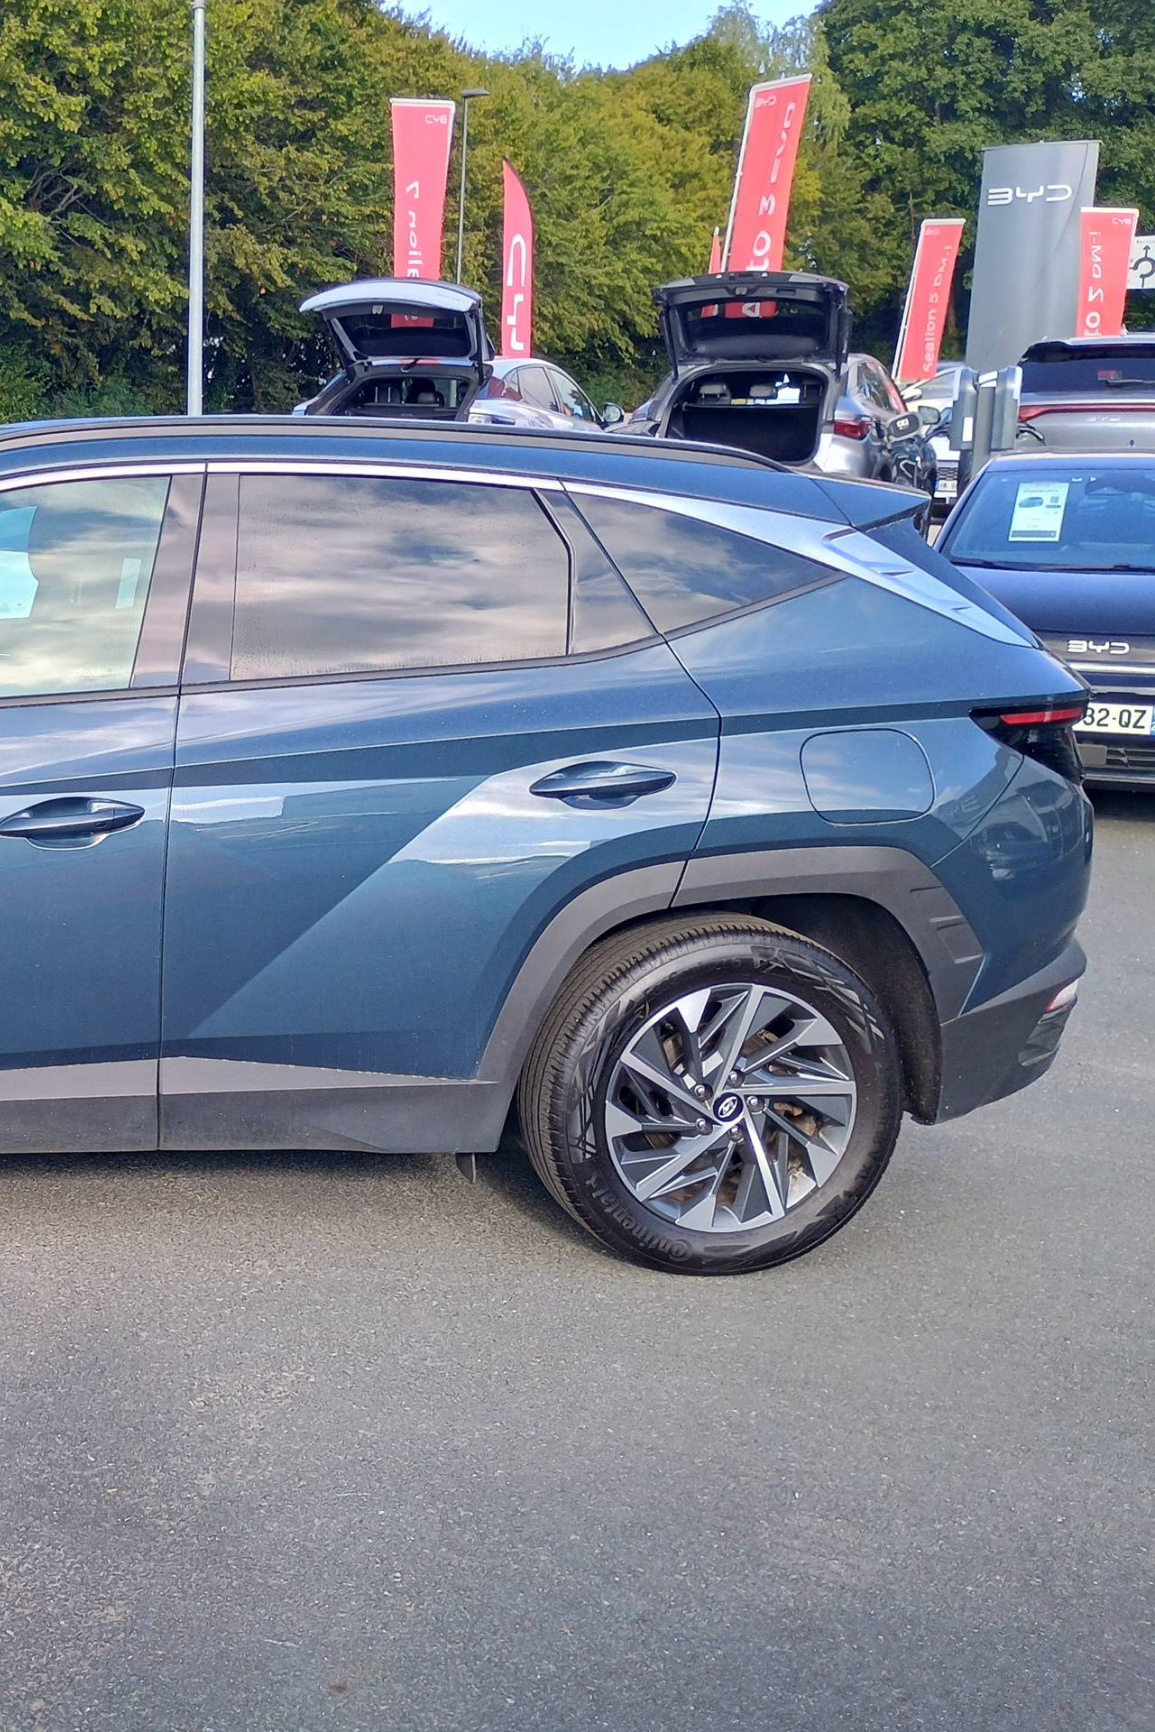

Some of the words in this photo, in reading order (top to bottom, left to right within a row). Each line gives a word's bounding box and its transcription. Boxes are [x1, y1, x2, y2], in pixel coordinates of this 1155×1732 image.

[987, 184, 1073, 206] BYD
[742, 230, 772, 318] Ato
[758, 193, 776, 216] 3
[928, 292, 939, 303] 5
[923, 309, 937, 373] Sealion
[1067, 639, 1130, 655] BYD
[1082, 706, 1148, 730] 32-QZ
